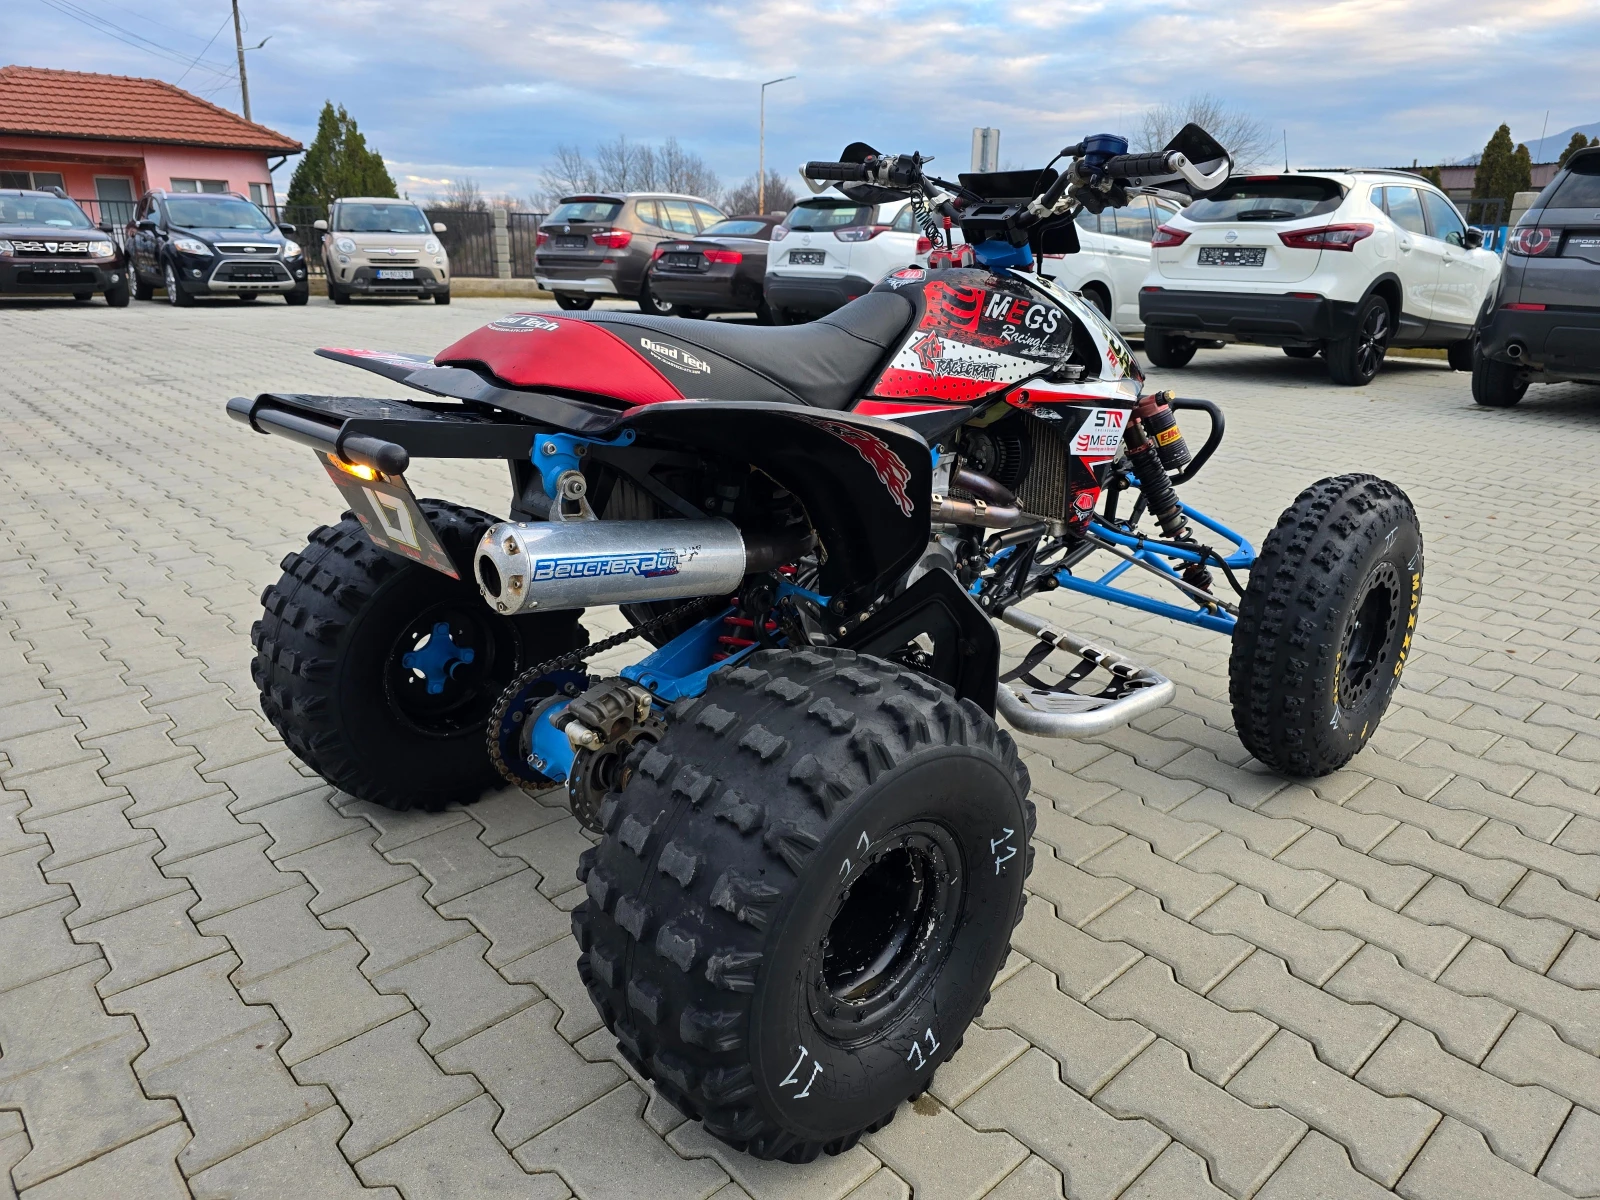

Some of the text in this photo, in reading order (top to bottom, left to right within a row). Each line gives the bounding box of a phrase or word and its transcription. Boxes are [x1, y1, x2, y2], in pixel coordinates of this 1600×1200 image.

[521, 317, 560, 331] Tech
[984, 293, 1062, 334] MEGS
[1000, 324, 1051, 352] Racing!
[641, 337, 711, 374] Quad Tech
[1089, 435, 1119, 446] MEGS
[1394, 572, 1420, 678] MAXXIS
